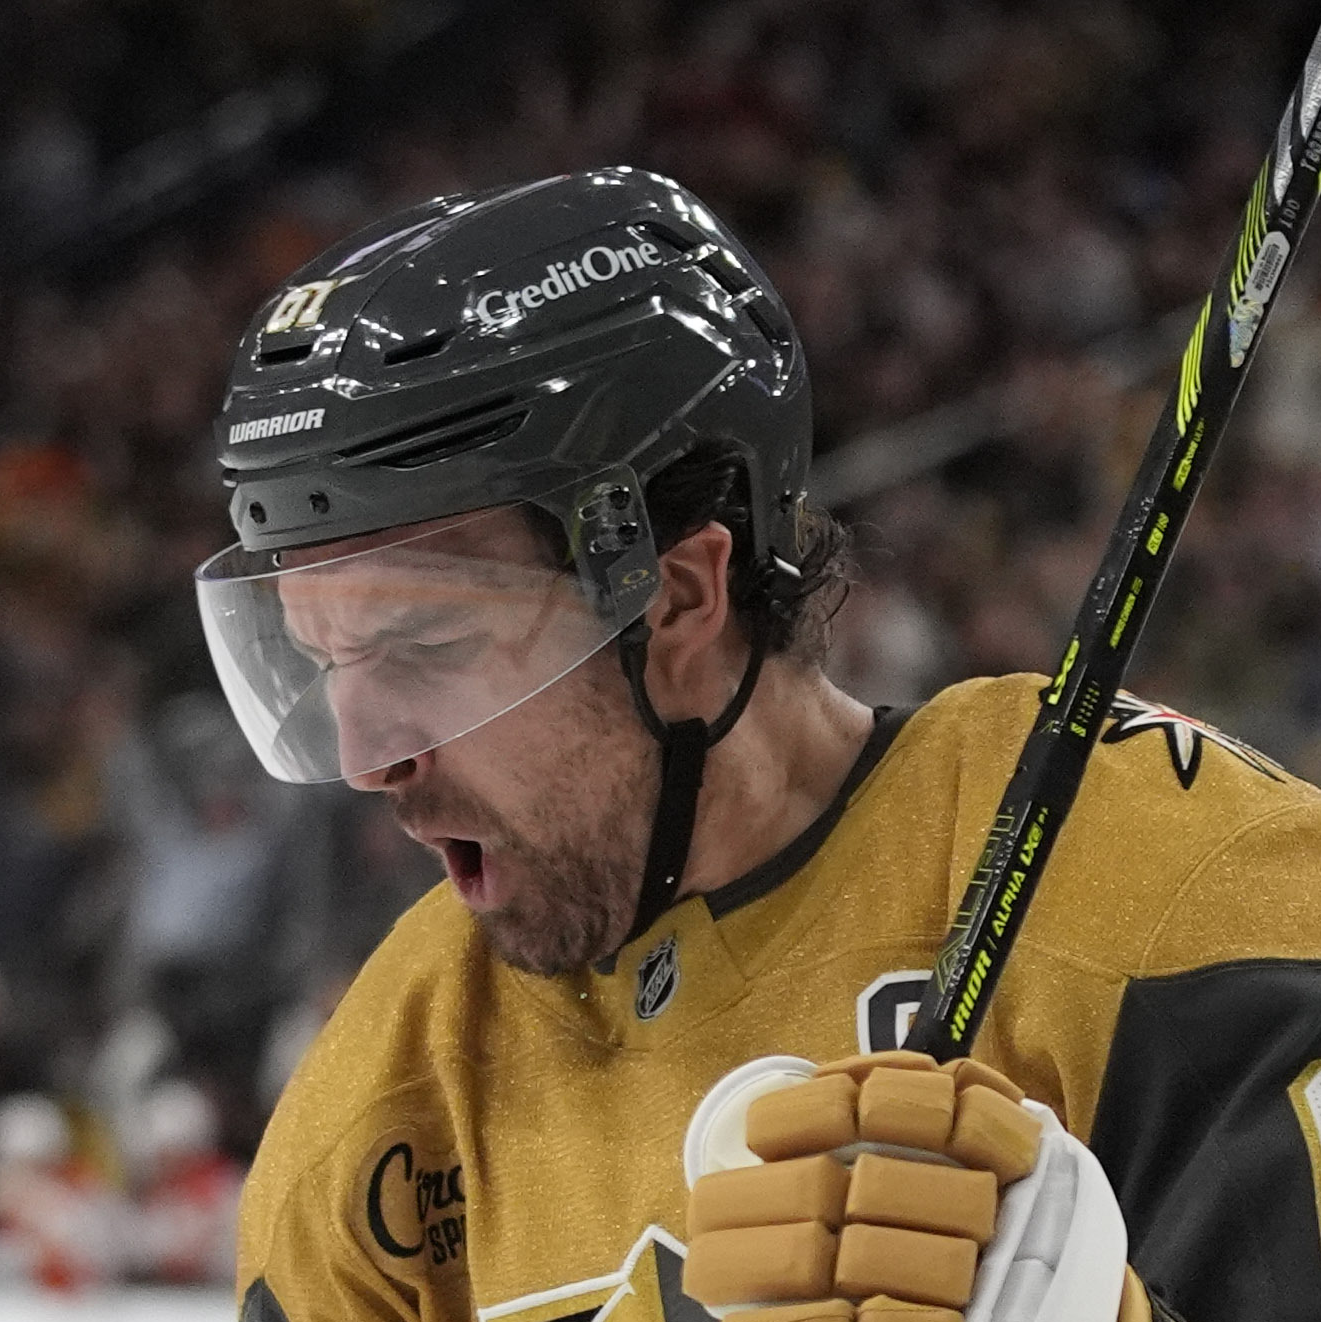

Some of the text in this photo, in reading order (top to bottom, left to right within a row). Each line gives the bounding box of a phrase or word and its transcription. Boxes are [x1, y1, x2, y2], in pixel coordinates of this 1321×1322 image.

[477, 241, 663, 326] CreditOne
[229, 408, 325, 444] WARRIOR
[992, 870, 1026, 938] ALPHA
[367, 1142, 466, 1259] Circ
